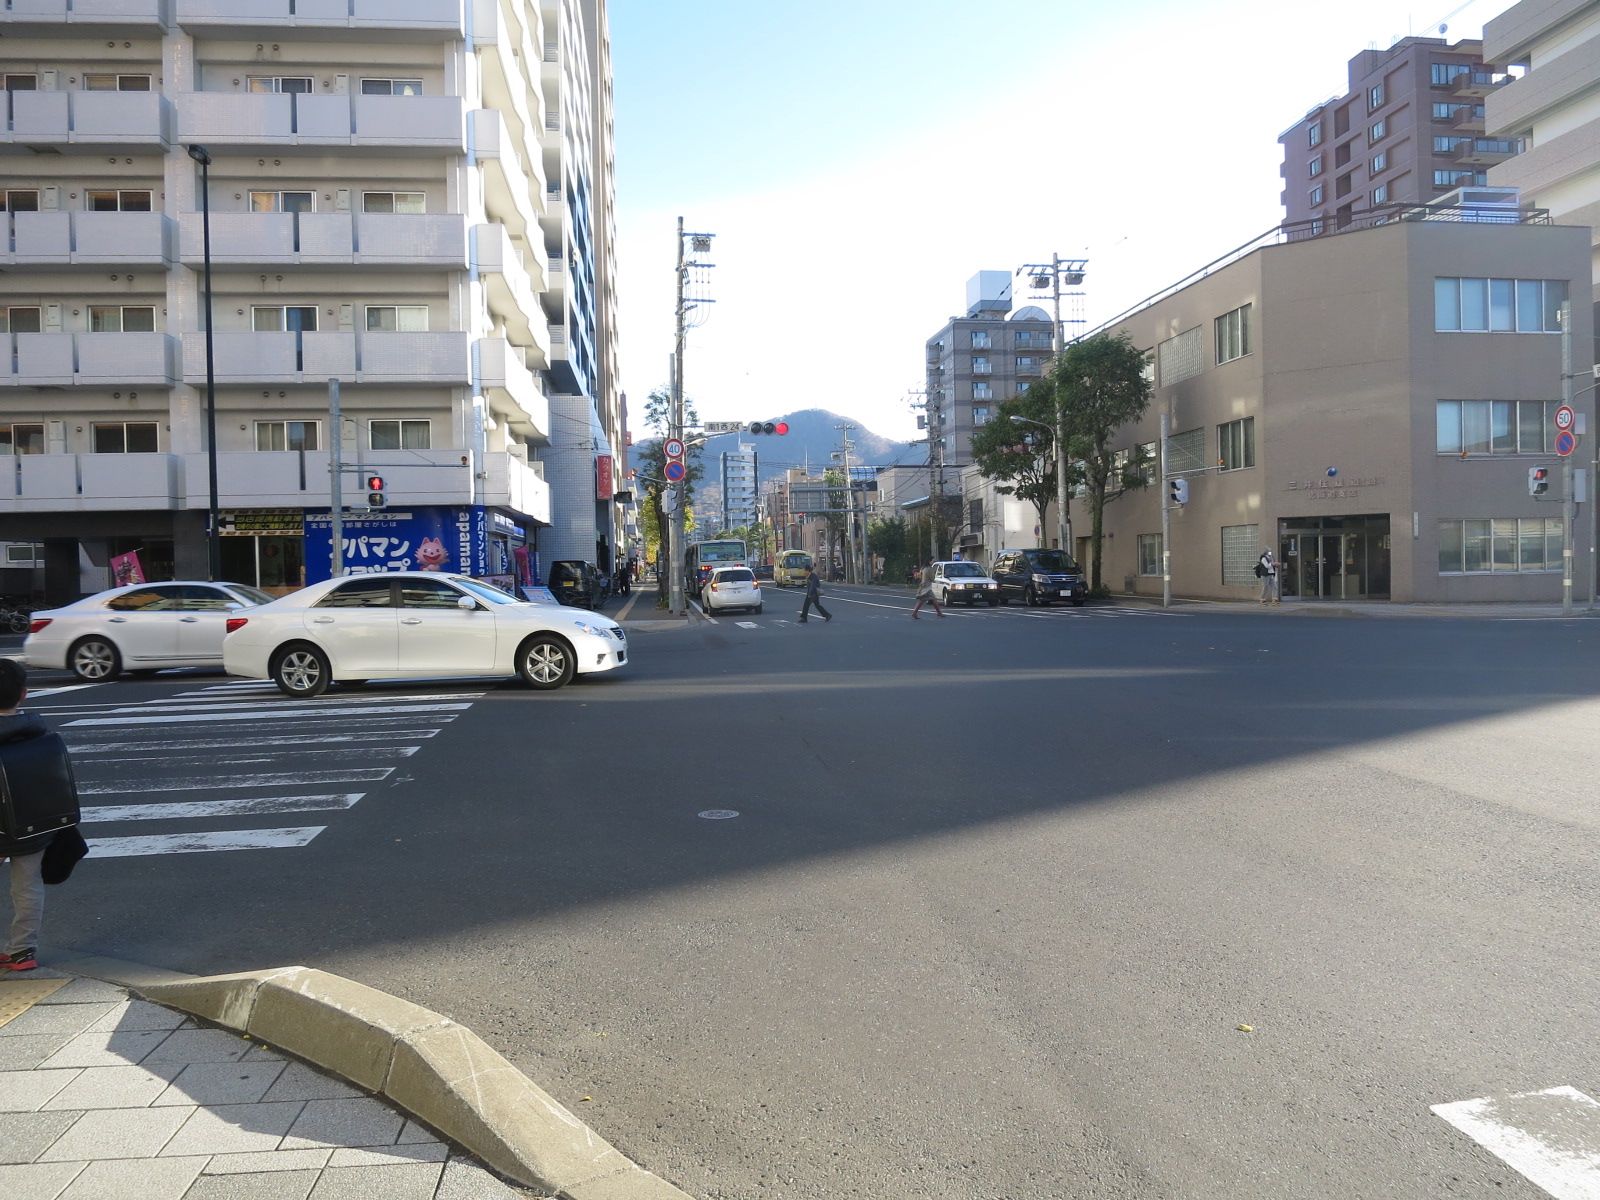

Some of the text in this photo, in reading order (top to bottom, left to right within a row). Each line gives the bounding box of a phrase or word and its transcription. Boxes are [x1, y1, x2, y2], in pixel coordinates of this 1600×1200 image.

[1559, 412, 1569, 424] 50
[669, 444, 680, 453] 40
[310, 521, 397, 529] 全国の部屋さがしは
[455, 512, 471, 576] apaman
